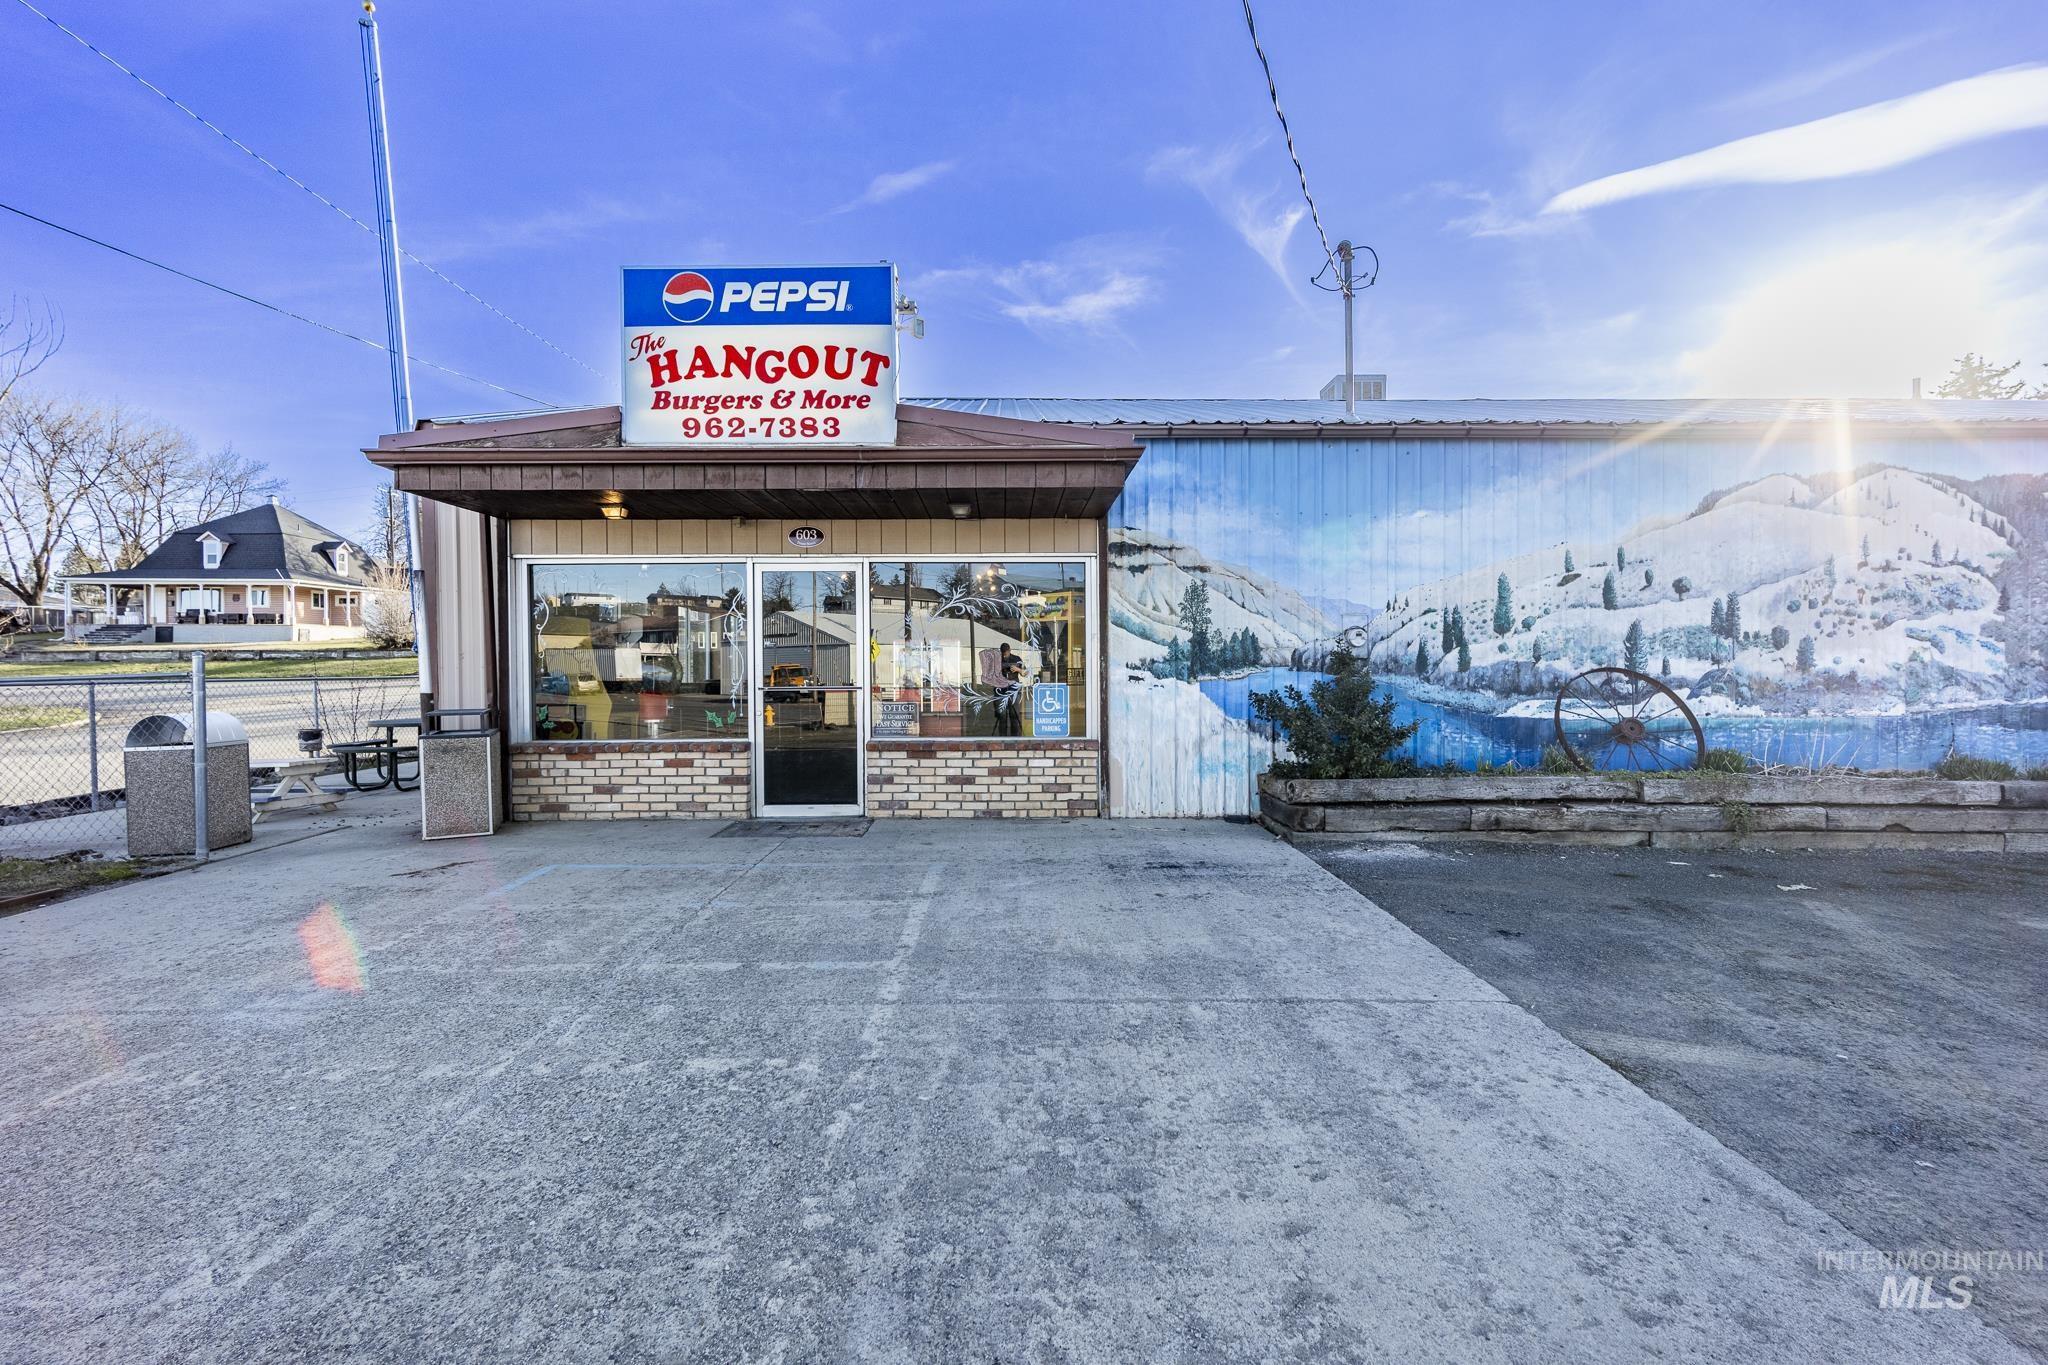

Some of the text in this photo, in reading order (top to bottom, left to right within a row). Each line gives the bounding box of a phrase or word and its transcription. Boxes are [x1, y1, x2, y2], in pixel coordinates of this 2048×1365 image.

[720, 280, 850, 312] PEPSI
[629, 331, 666, 362] The
[647, 344, 890, 388] HANGOUT
[651, 389, 871, 415] Burgers & More
[682, 416, 841, 439] 962-7383
[796, 529, 817, 540] 603
